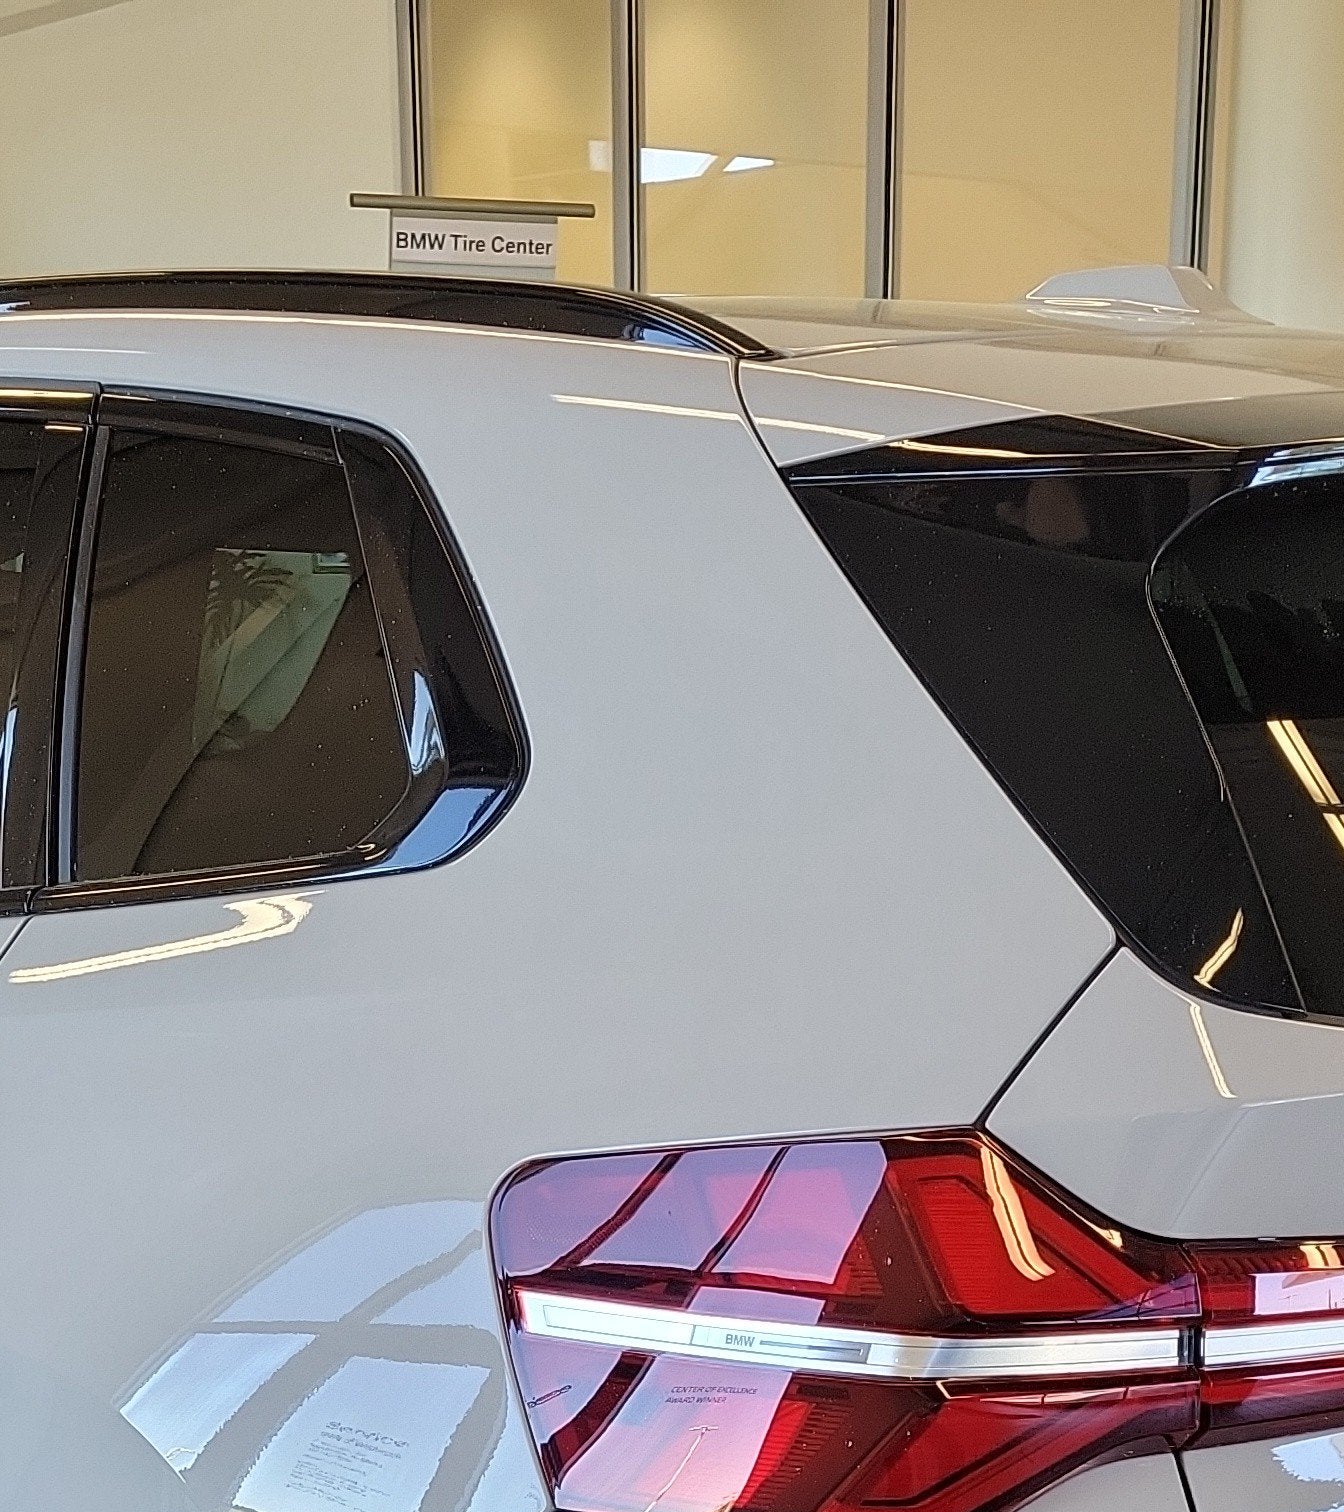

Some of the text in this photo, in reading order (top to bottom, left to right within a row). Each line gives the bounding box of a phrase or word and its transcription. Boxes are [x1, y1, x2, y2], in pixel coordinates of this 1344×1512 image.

[396, 231, 554, 255] BMW Tire Center
[725, 1333, 756, 1348] BMW
[670, 1386, 705, 1394] CENTER
